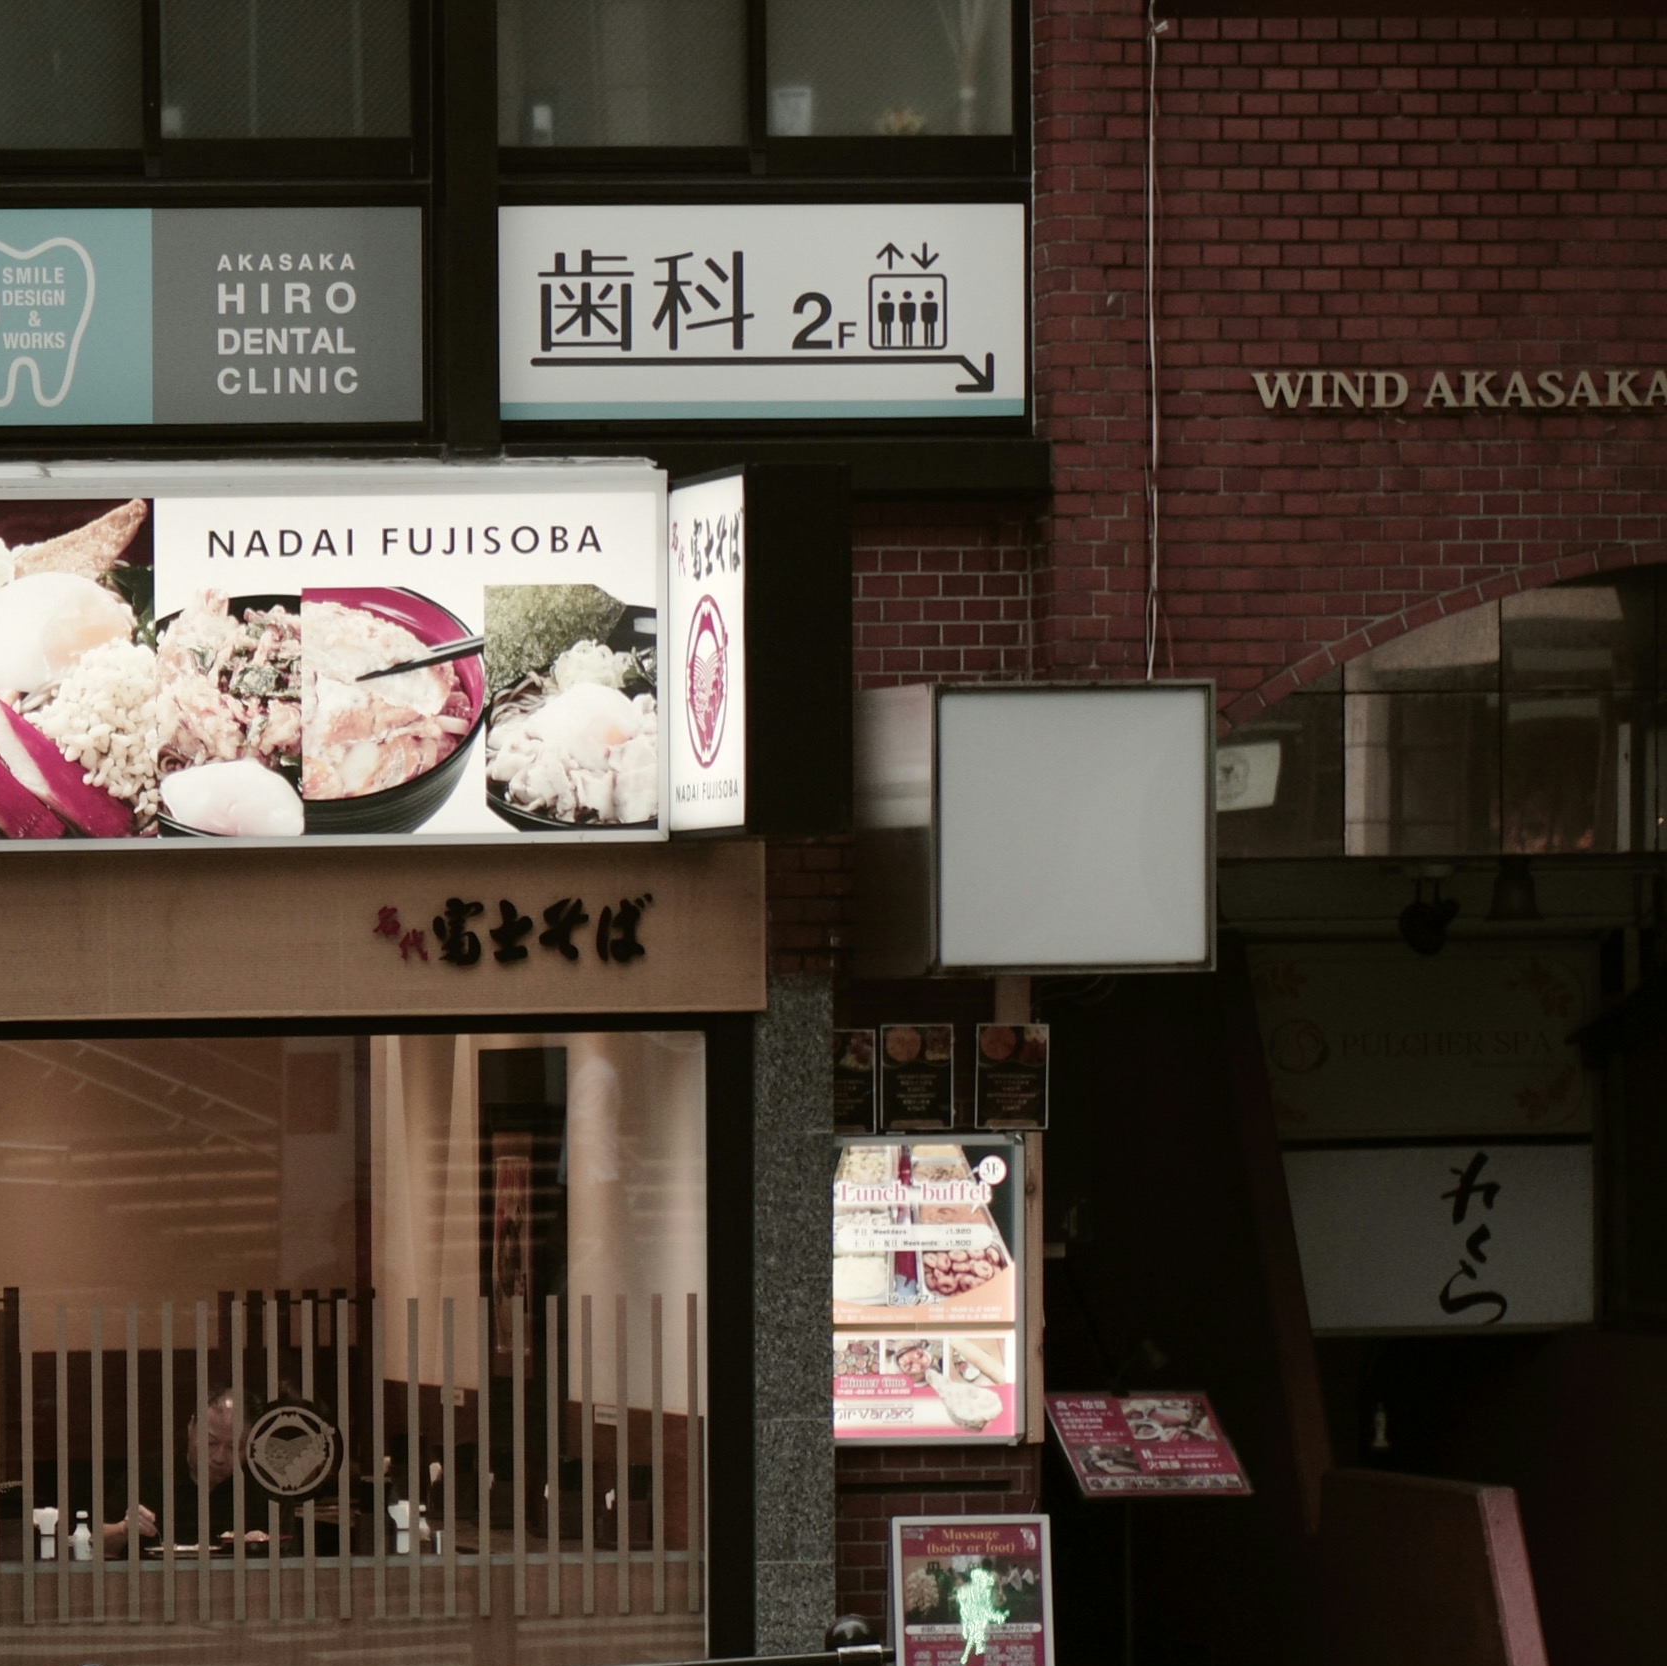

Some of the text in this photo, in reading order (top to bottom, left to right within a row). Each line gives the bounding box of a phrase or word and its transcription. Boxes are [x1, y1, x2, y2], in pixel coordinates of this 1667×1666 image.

[217, 253, 355, 272] AKASAKA
[2, 267, 65, 284] SMILE
[2, 289, 65, 306] DESIGN
[218, 281, 356, 314] HIRO
[538, 249, 857, 352] 歯科 2F
[28, 311, 41, 327] &
[3, 332, 66, 349] WORKS
[218, 328, 355, 355] DENTAL
[217, 366, 358, 394] CLINIC
[1251, 370, 1667, 409] WIND AKASAKA
[207, 523, 602, 560] NADAI FUJISOBA
[691, 506, 744, 581] 富士そば
[675, 779, 739, 804] NADAI FUJISOBA
[373, 892, 653, 966] 名代 富士そば
[1341, 1031, 1555, 1057] PULCHER SPA
[983, 1162, 1001, 1176] 3F
[841, 1183, 989, 1202] Lunch buffet
[942, 1528, 1000, 1541] Massage
[927, 1543, 1015, 1554] (body or foot)
